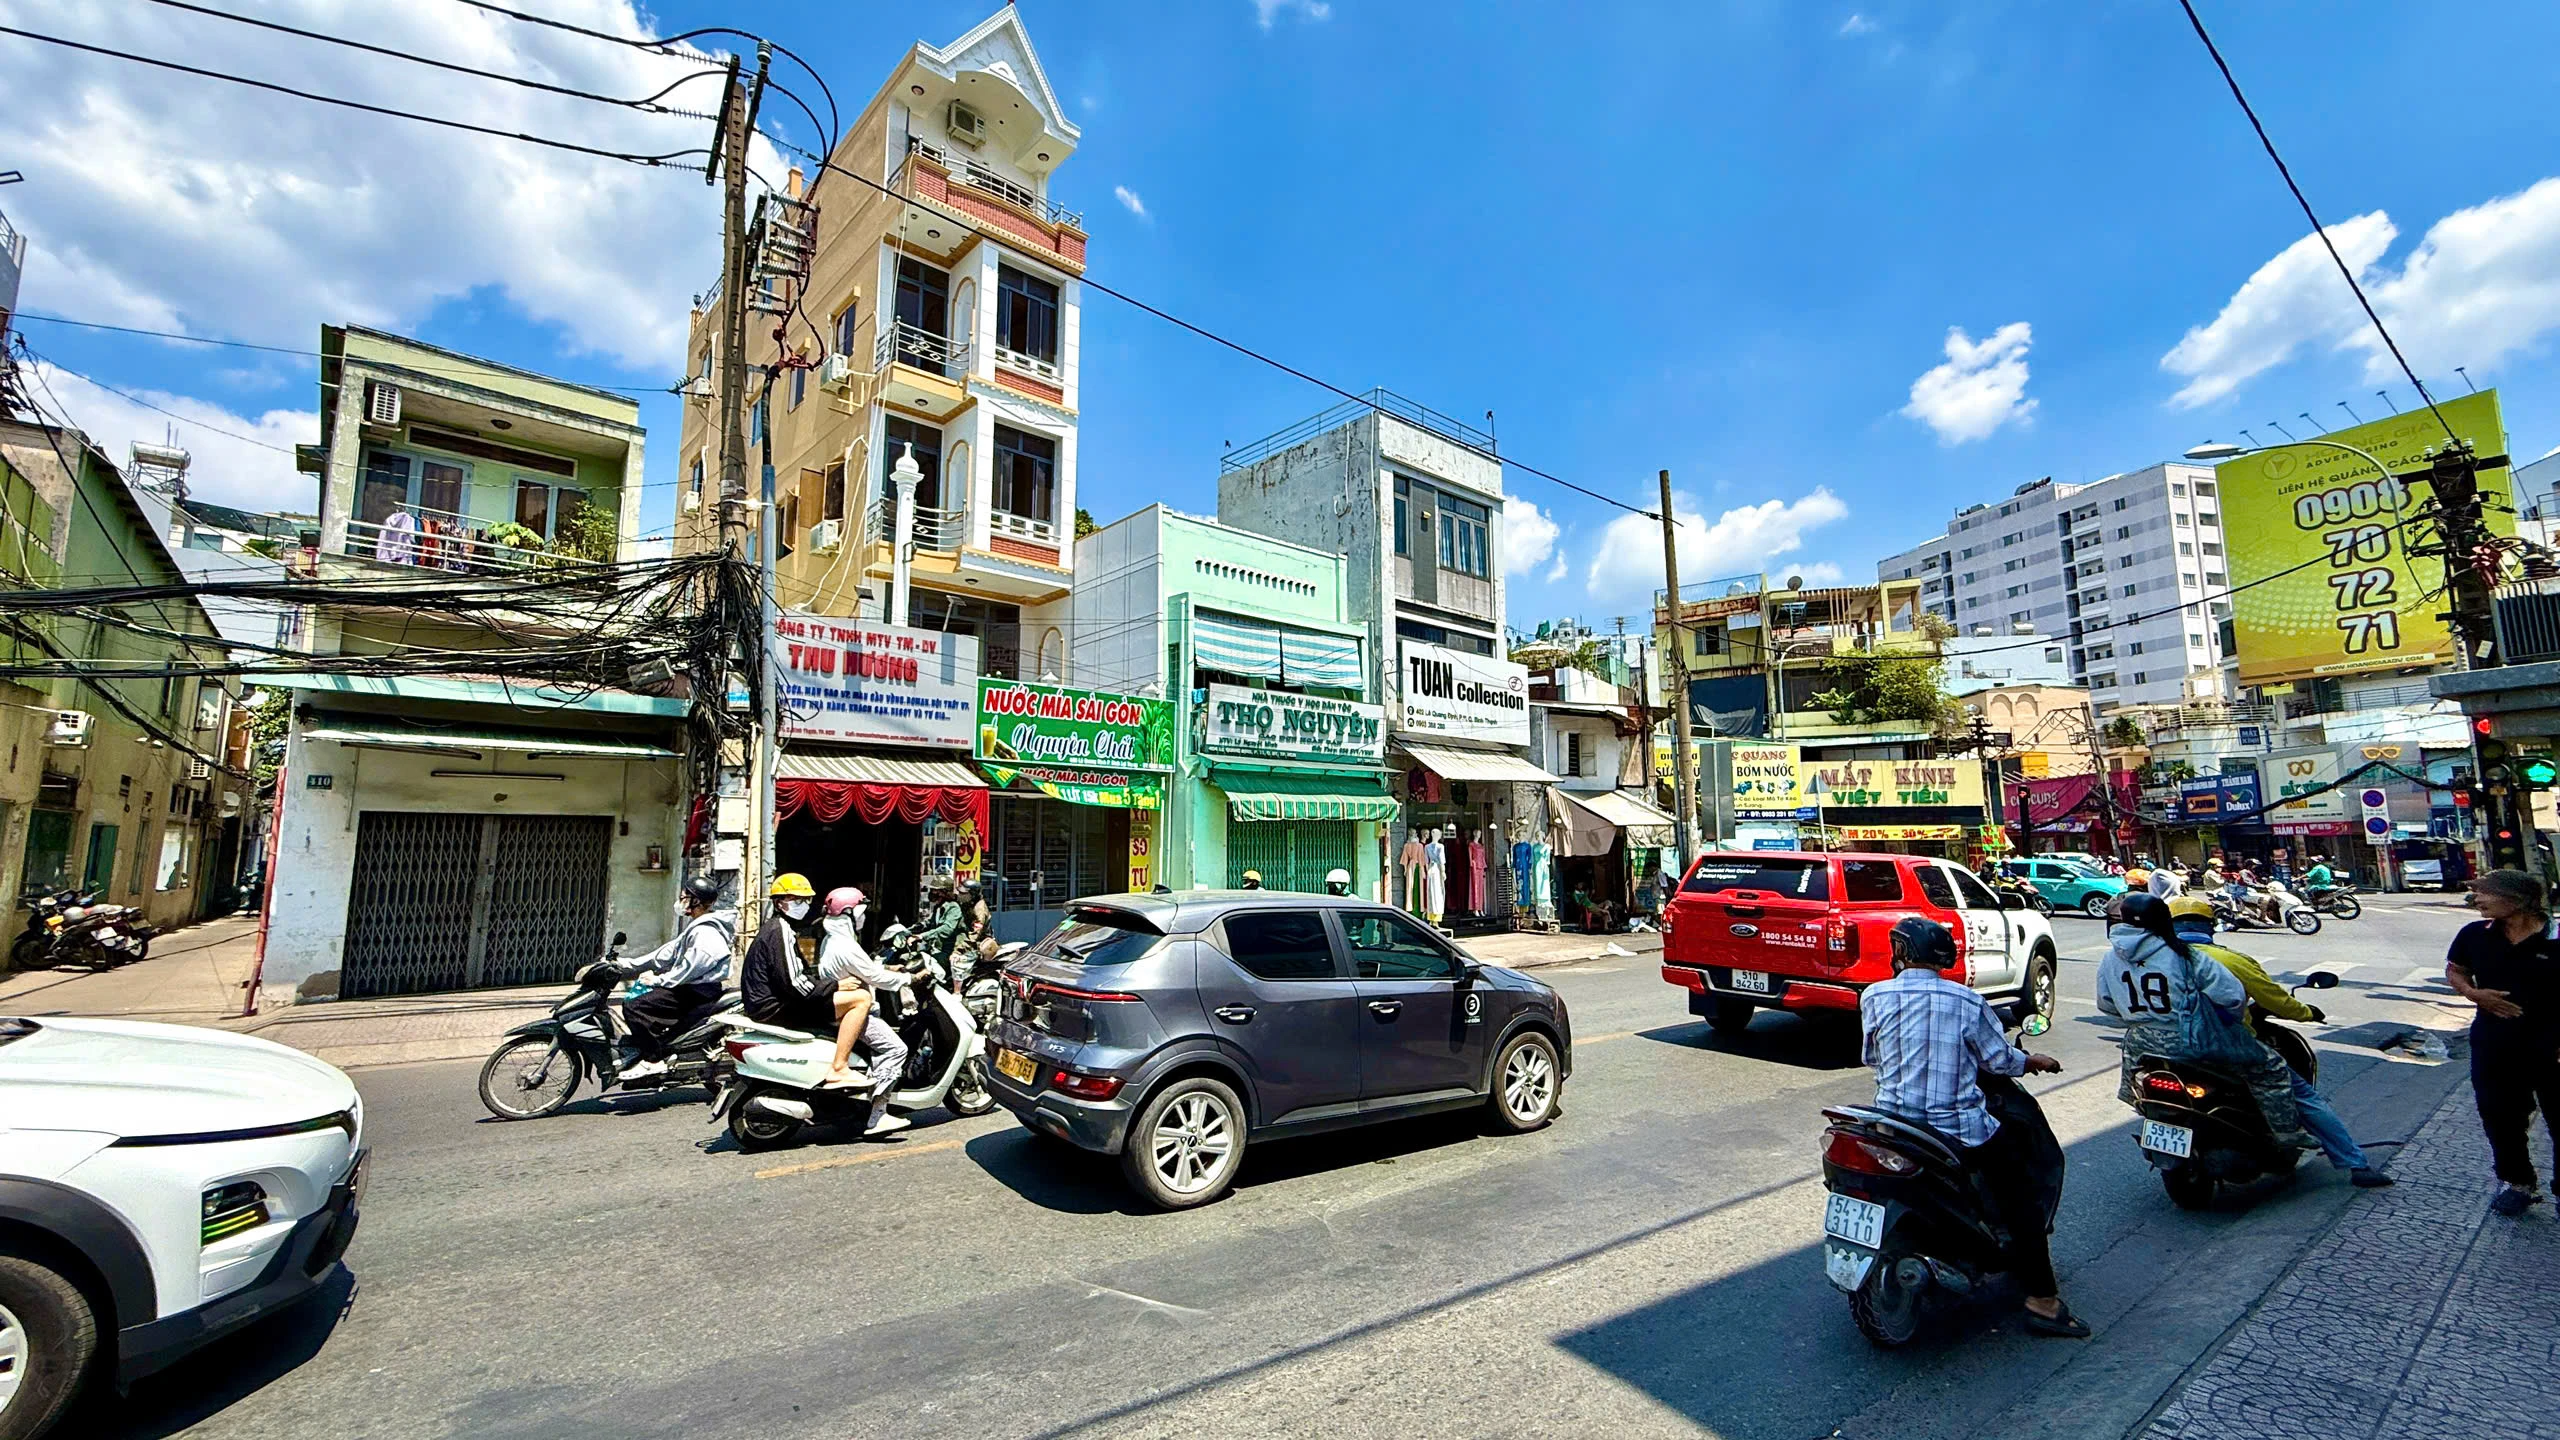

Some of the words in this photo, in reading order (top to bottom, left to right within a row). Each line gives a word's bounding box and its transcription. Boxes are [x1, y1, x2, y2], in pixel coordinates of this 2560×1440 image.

[2278, 481, 2304, 496] LIÊN
[2308, 476, 2325, 489] HỆ
[2387, 453, 2423, 469] CÁO
[2295, 476, 2412, 530] 0908
[2323, 523, 2390, 568] 70
[2328, 567, 2397, 611] 72
[810, 624, 825, 640] TY
[830, 627, 861, 644] TNHH
[866, 632, 891, 649] MTV
[2337, 610, 2401, 654] 71
[788, 644, 836, 674] THU
[843, 651, 918, 683] HƯƠNG
[1410, 656, 1453, 700] TUAN
[985, 683, 1038, 716] NƯỚC
[1041, 688, 1071, 720] MÍA
[1075, 693, 1103, 724] SÀI
[1106, 695, 1144, 727] GÒN
[1217, 701, 1274, 734] THỌ
[1095, 730, 1135, 759] Chất
[1741, 750, 1787, 760] QUANG
[1080, 770, 1099, 785] SÀI
[1101, 772, 1129, 786] GÒN
[1737, 764, 1761, 777] BƠM
[1764, 763, 1795, 777] NƯỚC
[1820, 760, 1872, 786] MẮT
[1895, 762, 1956, 785] KÍNH
[1123, 786, 1131, 806] 5
[1832, 789, 1881, 806] VIỆT
[2226, 801, 2250, 811] Dulux
[1862, 829, 1889, 839] 20%
[1761, 932, 1780, 940] 1800
[2121, 970, 2172, 1014] 18
[2145, 1134, 2187, 1156] 041.11
[2151, 1123, 2185, 1141] 59-P2
[1835, 1198, 1874, 1224] 54-X4
[1832, 1215, 1872, 1242] 3110
